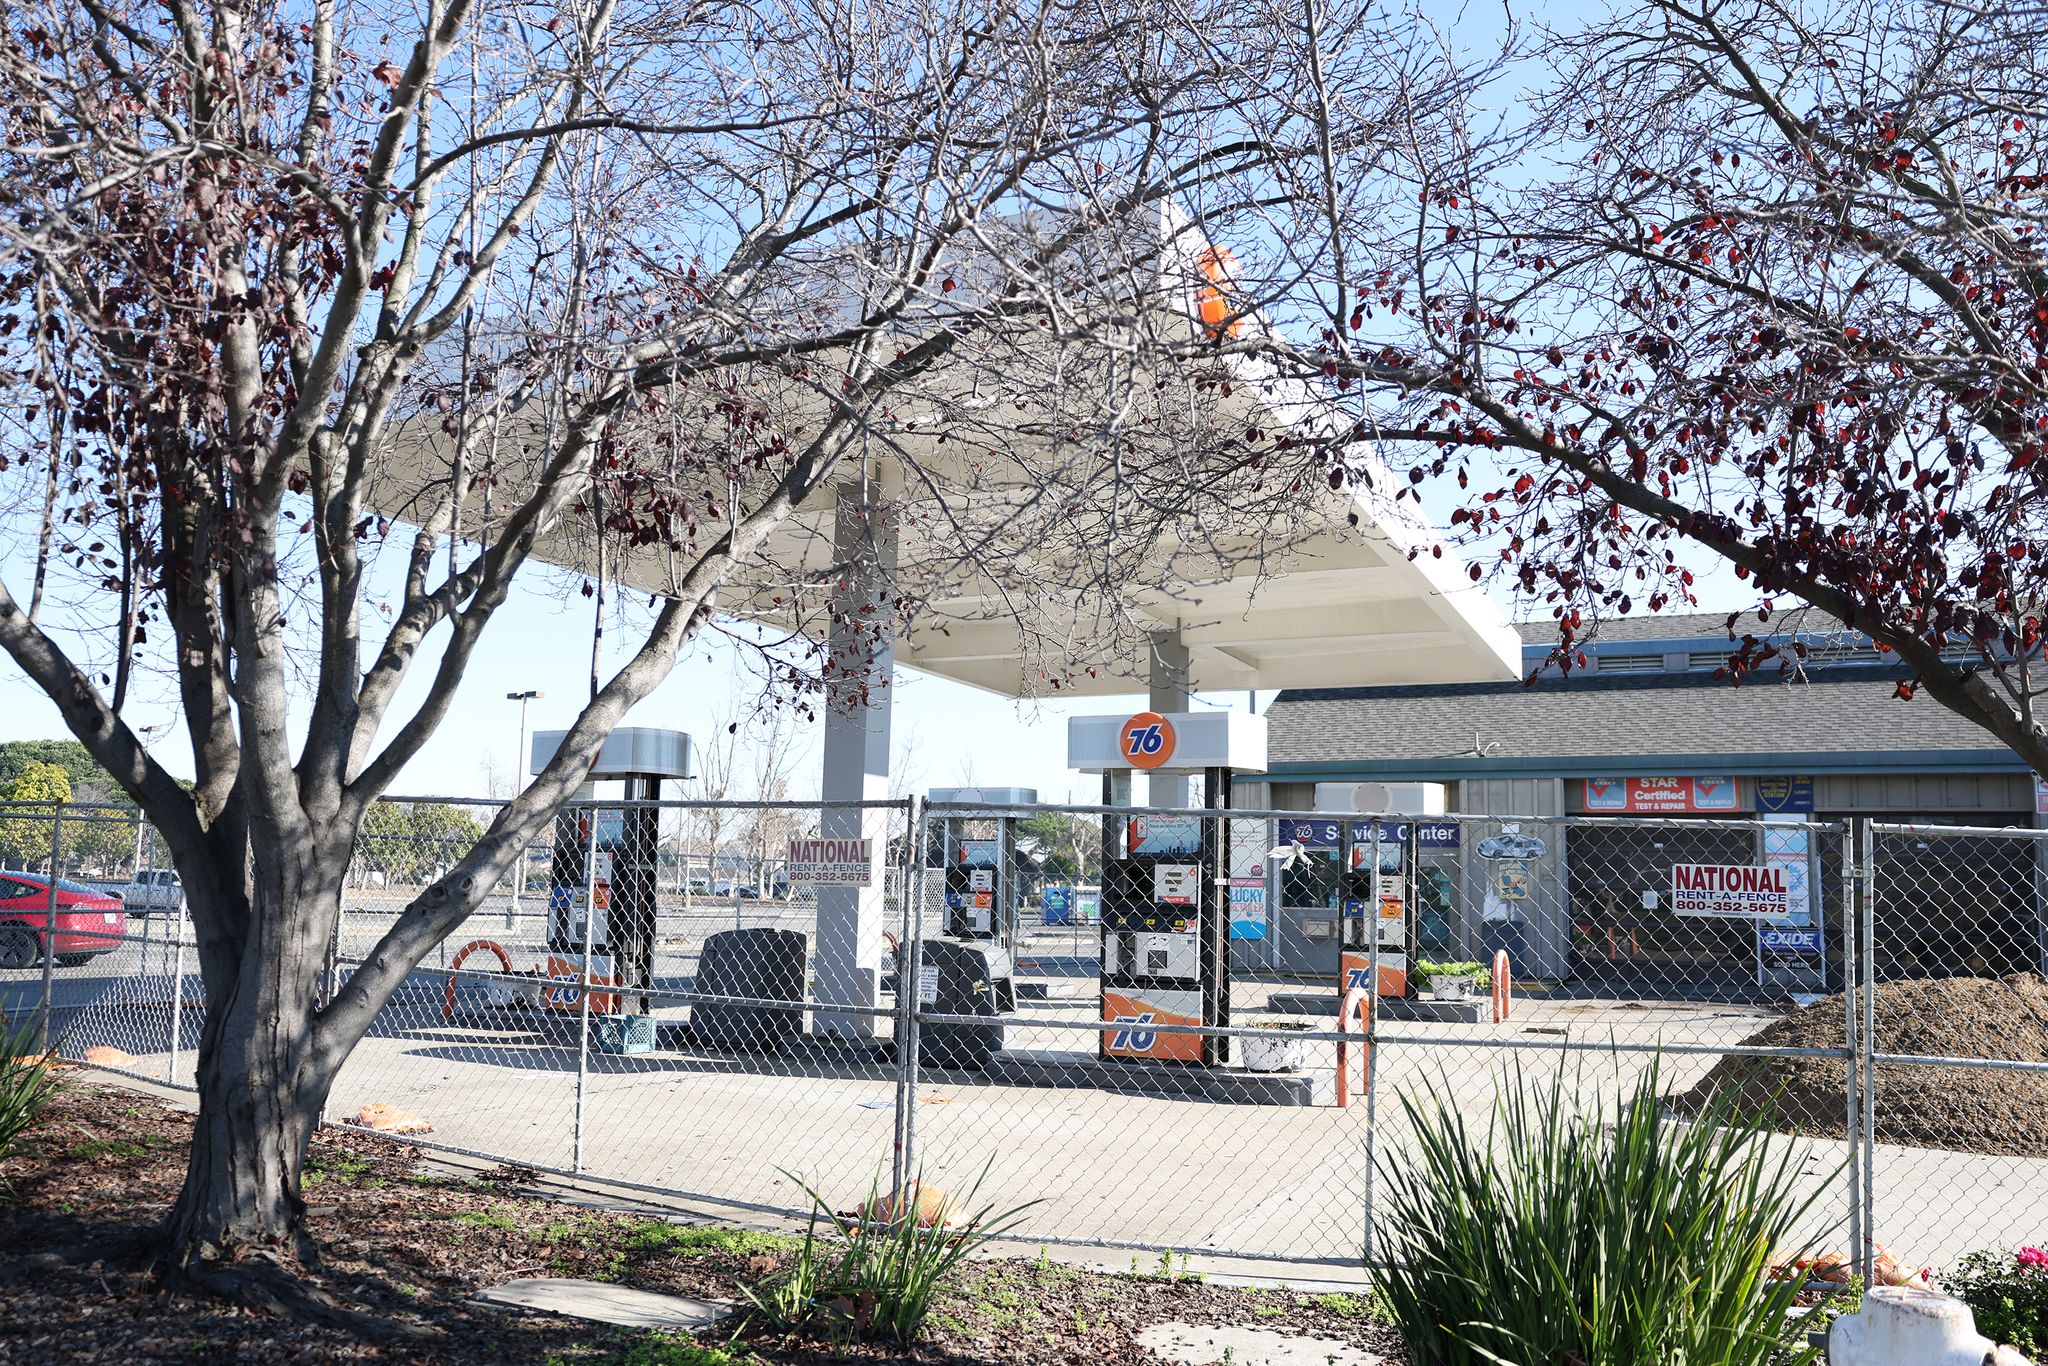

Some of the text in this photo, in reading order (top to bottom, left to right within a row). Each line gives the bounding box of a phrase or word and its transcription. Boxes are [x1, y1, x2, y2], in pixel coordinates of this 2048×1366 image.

[1127, 723, 1163, 755] 76
[1640, 777, 1679, 788] STAR
[1634, 790, 1686, 800] Certified
[1296, 825, 1312, 838] 76
[1325, 825, 1455, 840] Svie Cnter
[790, 840, 870, 863] NATIONAL
[790, 863, 869, 872] RENT-A-FENCE
[1189, 867, 1196, 877] 6
[790, 872, 869, 881] 800-352-5675
[1676, 866, 1787, 893] NATIONAL
[1230, 889, 1264, 902] LUCKY
[1676, 890, 1787, 902] RENT-A-FENCE
[1676, 901, 1787, 913] 800-352-5675
[1765, 932, 1815, 945] EXIDE
[551, 973, 580, 1004] 76
[1109, 1012, 1156, 1052] 76
